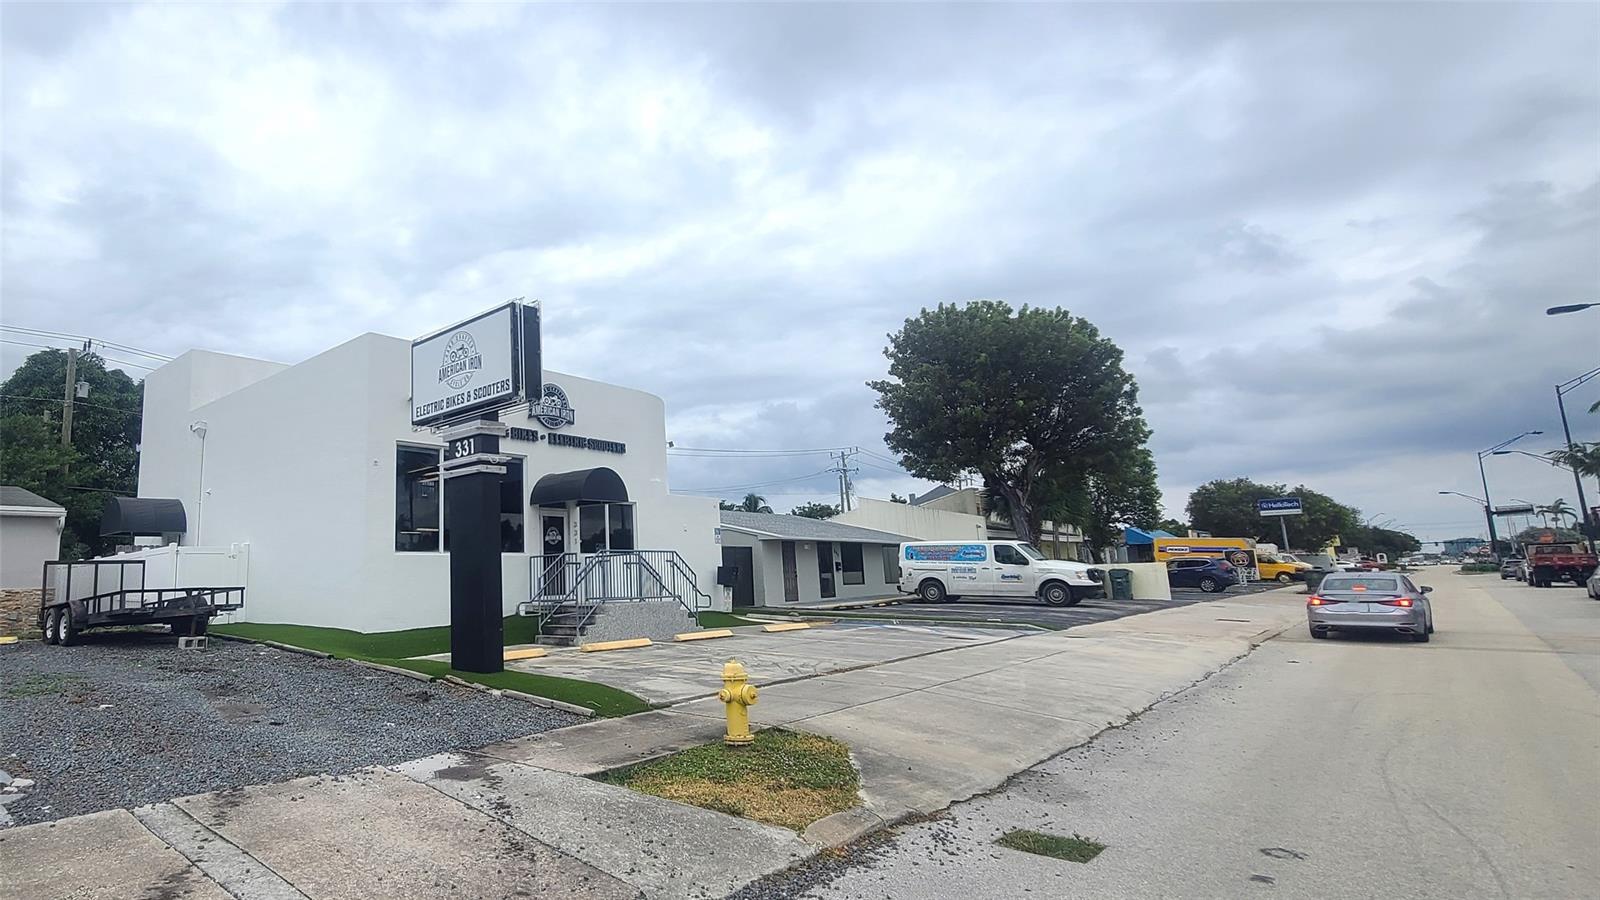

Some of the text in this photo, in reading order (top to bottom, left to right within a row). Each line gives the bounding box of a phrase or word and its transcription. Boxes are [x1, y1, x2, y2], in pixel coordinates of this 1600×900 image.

[438, 354, 482, 384] AMERICAN IRON
[416, 379, 510, 417] ELECTRIC BIKES & SCOOTERS
[531, 404, 559, 417] AMERICAN
[511, 427, 538, 441] BIKES
[455, 438, 474, 457] 331
